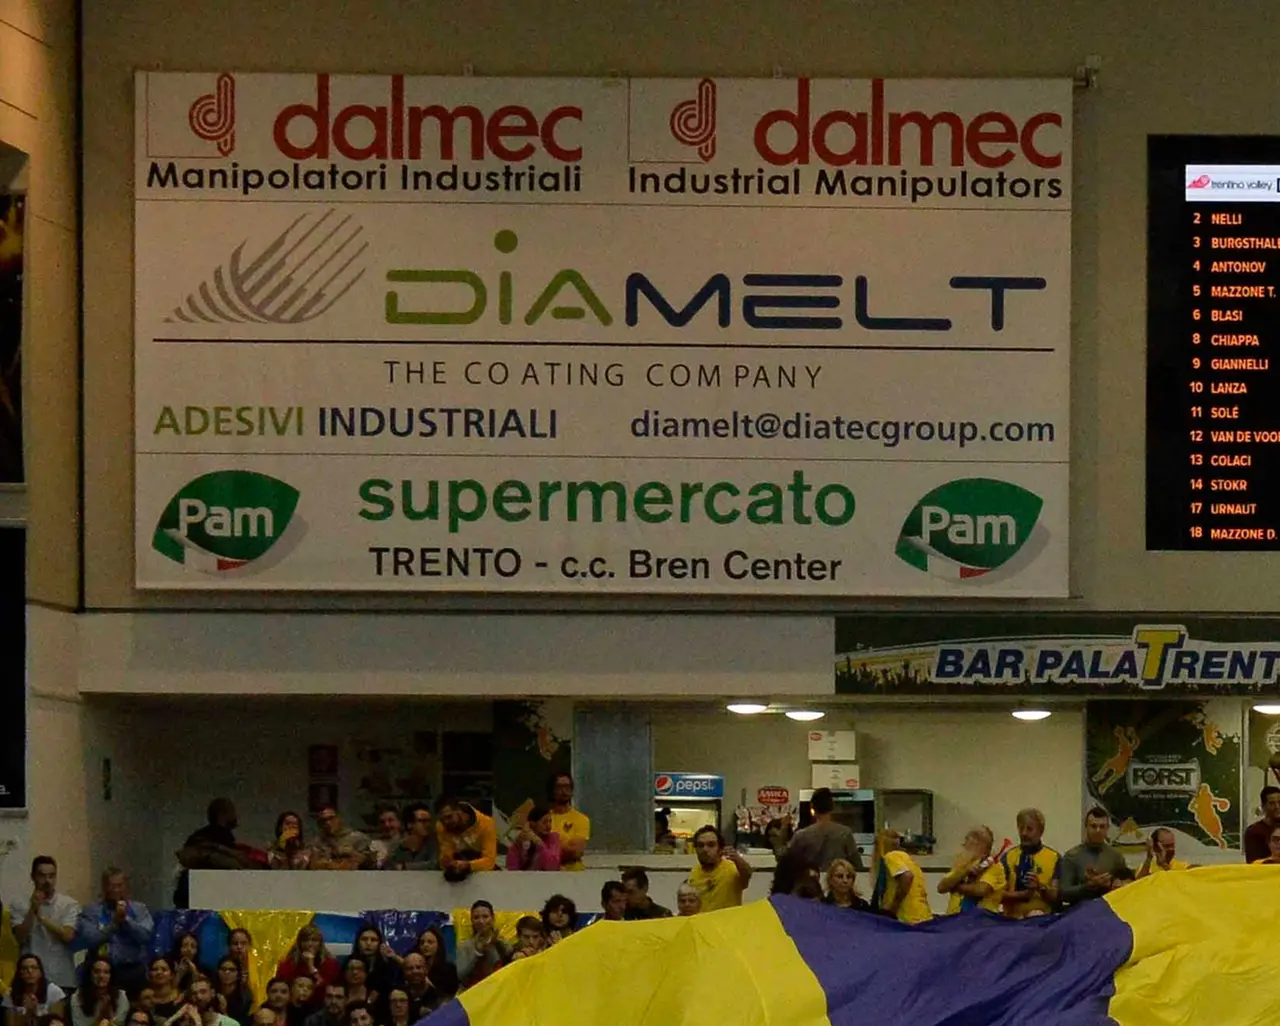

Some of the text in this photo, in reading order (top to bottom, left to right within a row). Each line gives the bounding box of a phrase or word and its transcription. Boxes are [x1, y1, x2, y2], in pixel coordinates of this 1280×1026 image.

[273, 72, 583, 166] dalmec
[753, 77, 1063, 169] dalmec
[147, 162, 580, 195] Manipolatori Industriali
[629, 167, 1062, 202] Industrial Manipulators
[1212, 214, 1241, 224] NELLI
[1211, 261, 1266, 272] ANTONOV
[1212, 286, 1264, 297] MAZZONE
[1212, 310, 1242, 321] BLASI
[1211, 335, 1259, 345] CHIAPPA
[1211, 359, 1268, 369] GIANNELLI
[384, 361, 446, 384] THE
[647, 364, 821, 388] COMPANY
[1211, 383, 1247, 393] LANZA
[153, 406, 556, 438] ADESIVI INDUSTRIALI
[631, 410, 1054, 447] diamelt@diatecgroup.com
[1211, 431, 1251, 442] VAN DE
[1211, 455, 1251, 466] COLACI
[1211, 480, 1247, 490] STOKR
[359, 470, 855, 533] supermercato
[1211, 504, 1256, 514] URNAUT
[177, 496, 273, 539] Pam
[921, 506, 1016, 545] Pam
[1211, 529, 1263, 539] MAZZONE
[369, 548, 841, 580] TRENTO c.c. Bren Center
[937, 648, 1027, 680] BAR
